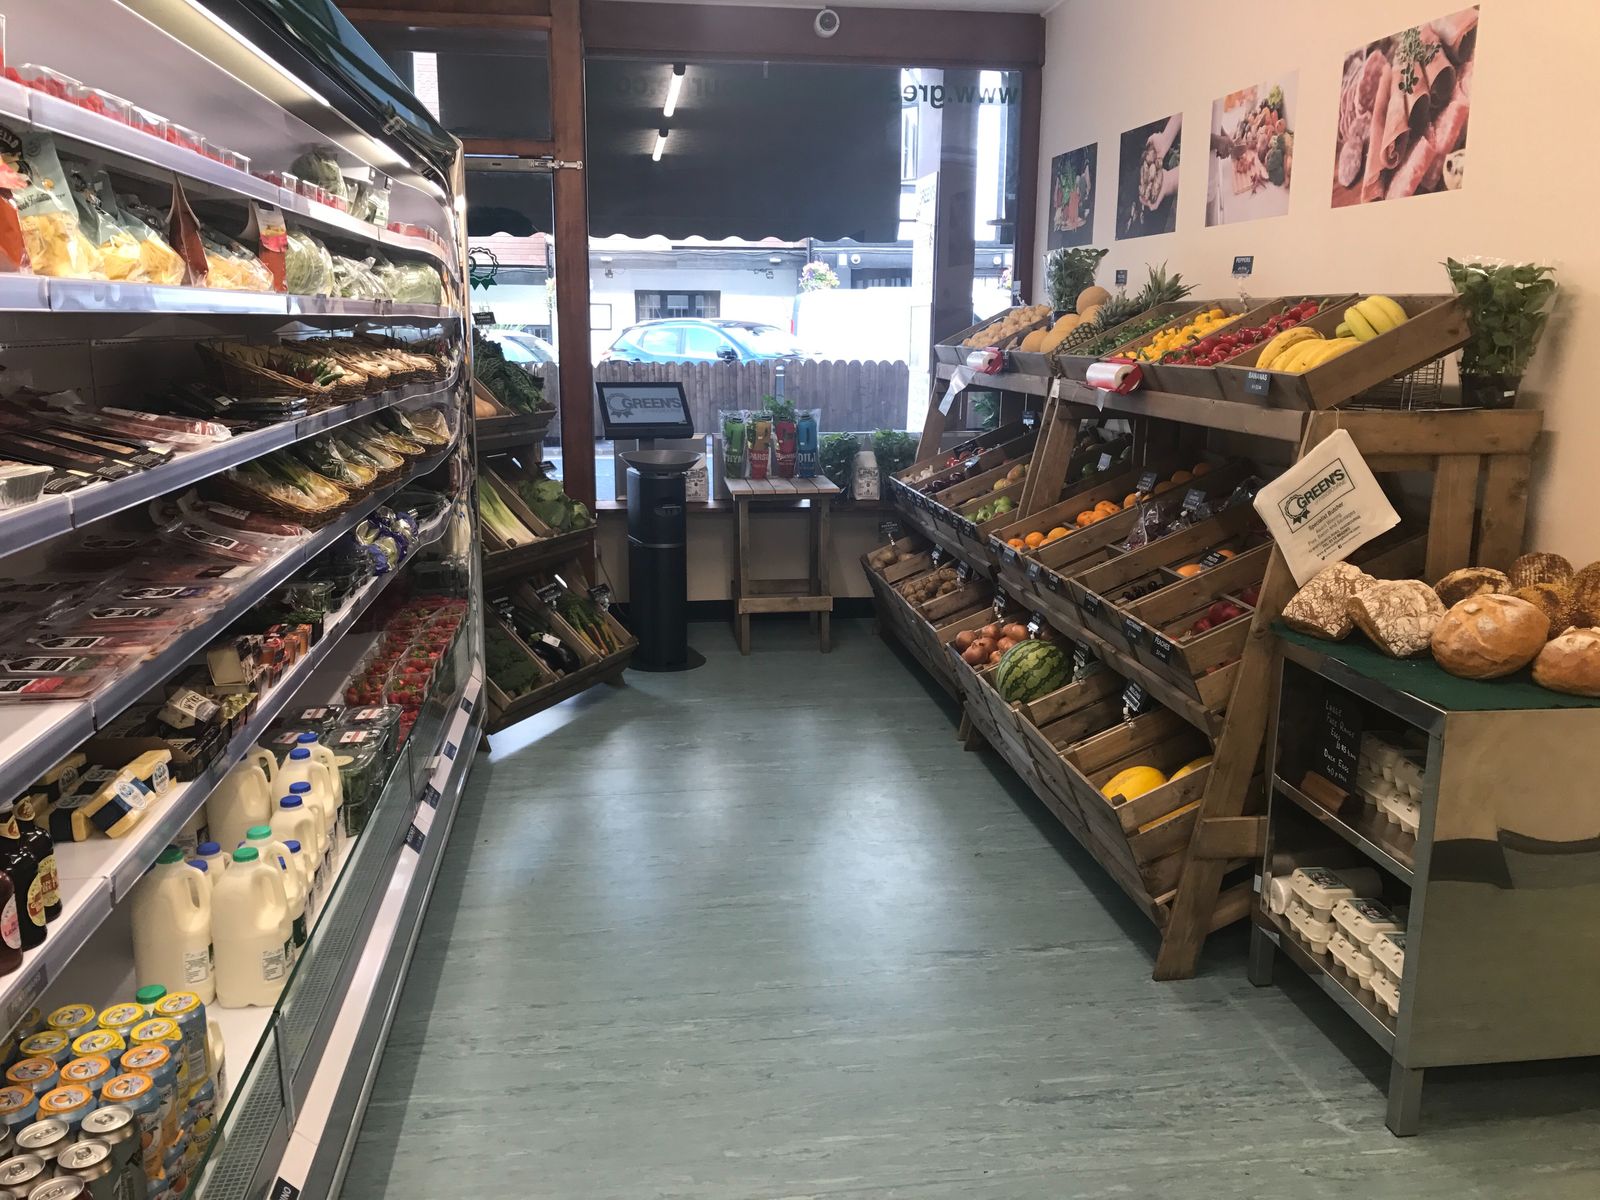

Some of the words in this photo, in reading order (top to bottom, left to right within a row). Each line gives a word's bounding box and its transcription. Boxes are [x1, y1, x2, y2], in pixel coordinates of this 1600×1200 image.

[1248, 371, 1267, 381] BANANAS
[622, 398, 681, 409] GREEN'S
[1297, 468, 1345, 510] GREEN'S
[1154, 636, 1171, 652] PEACHES
